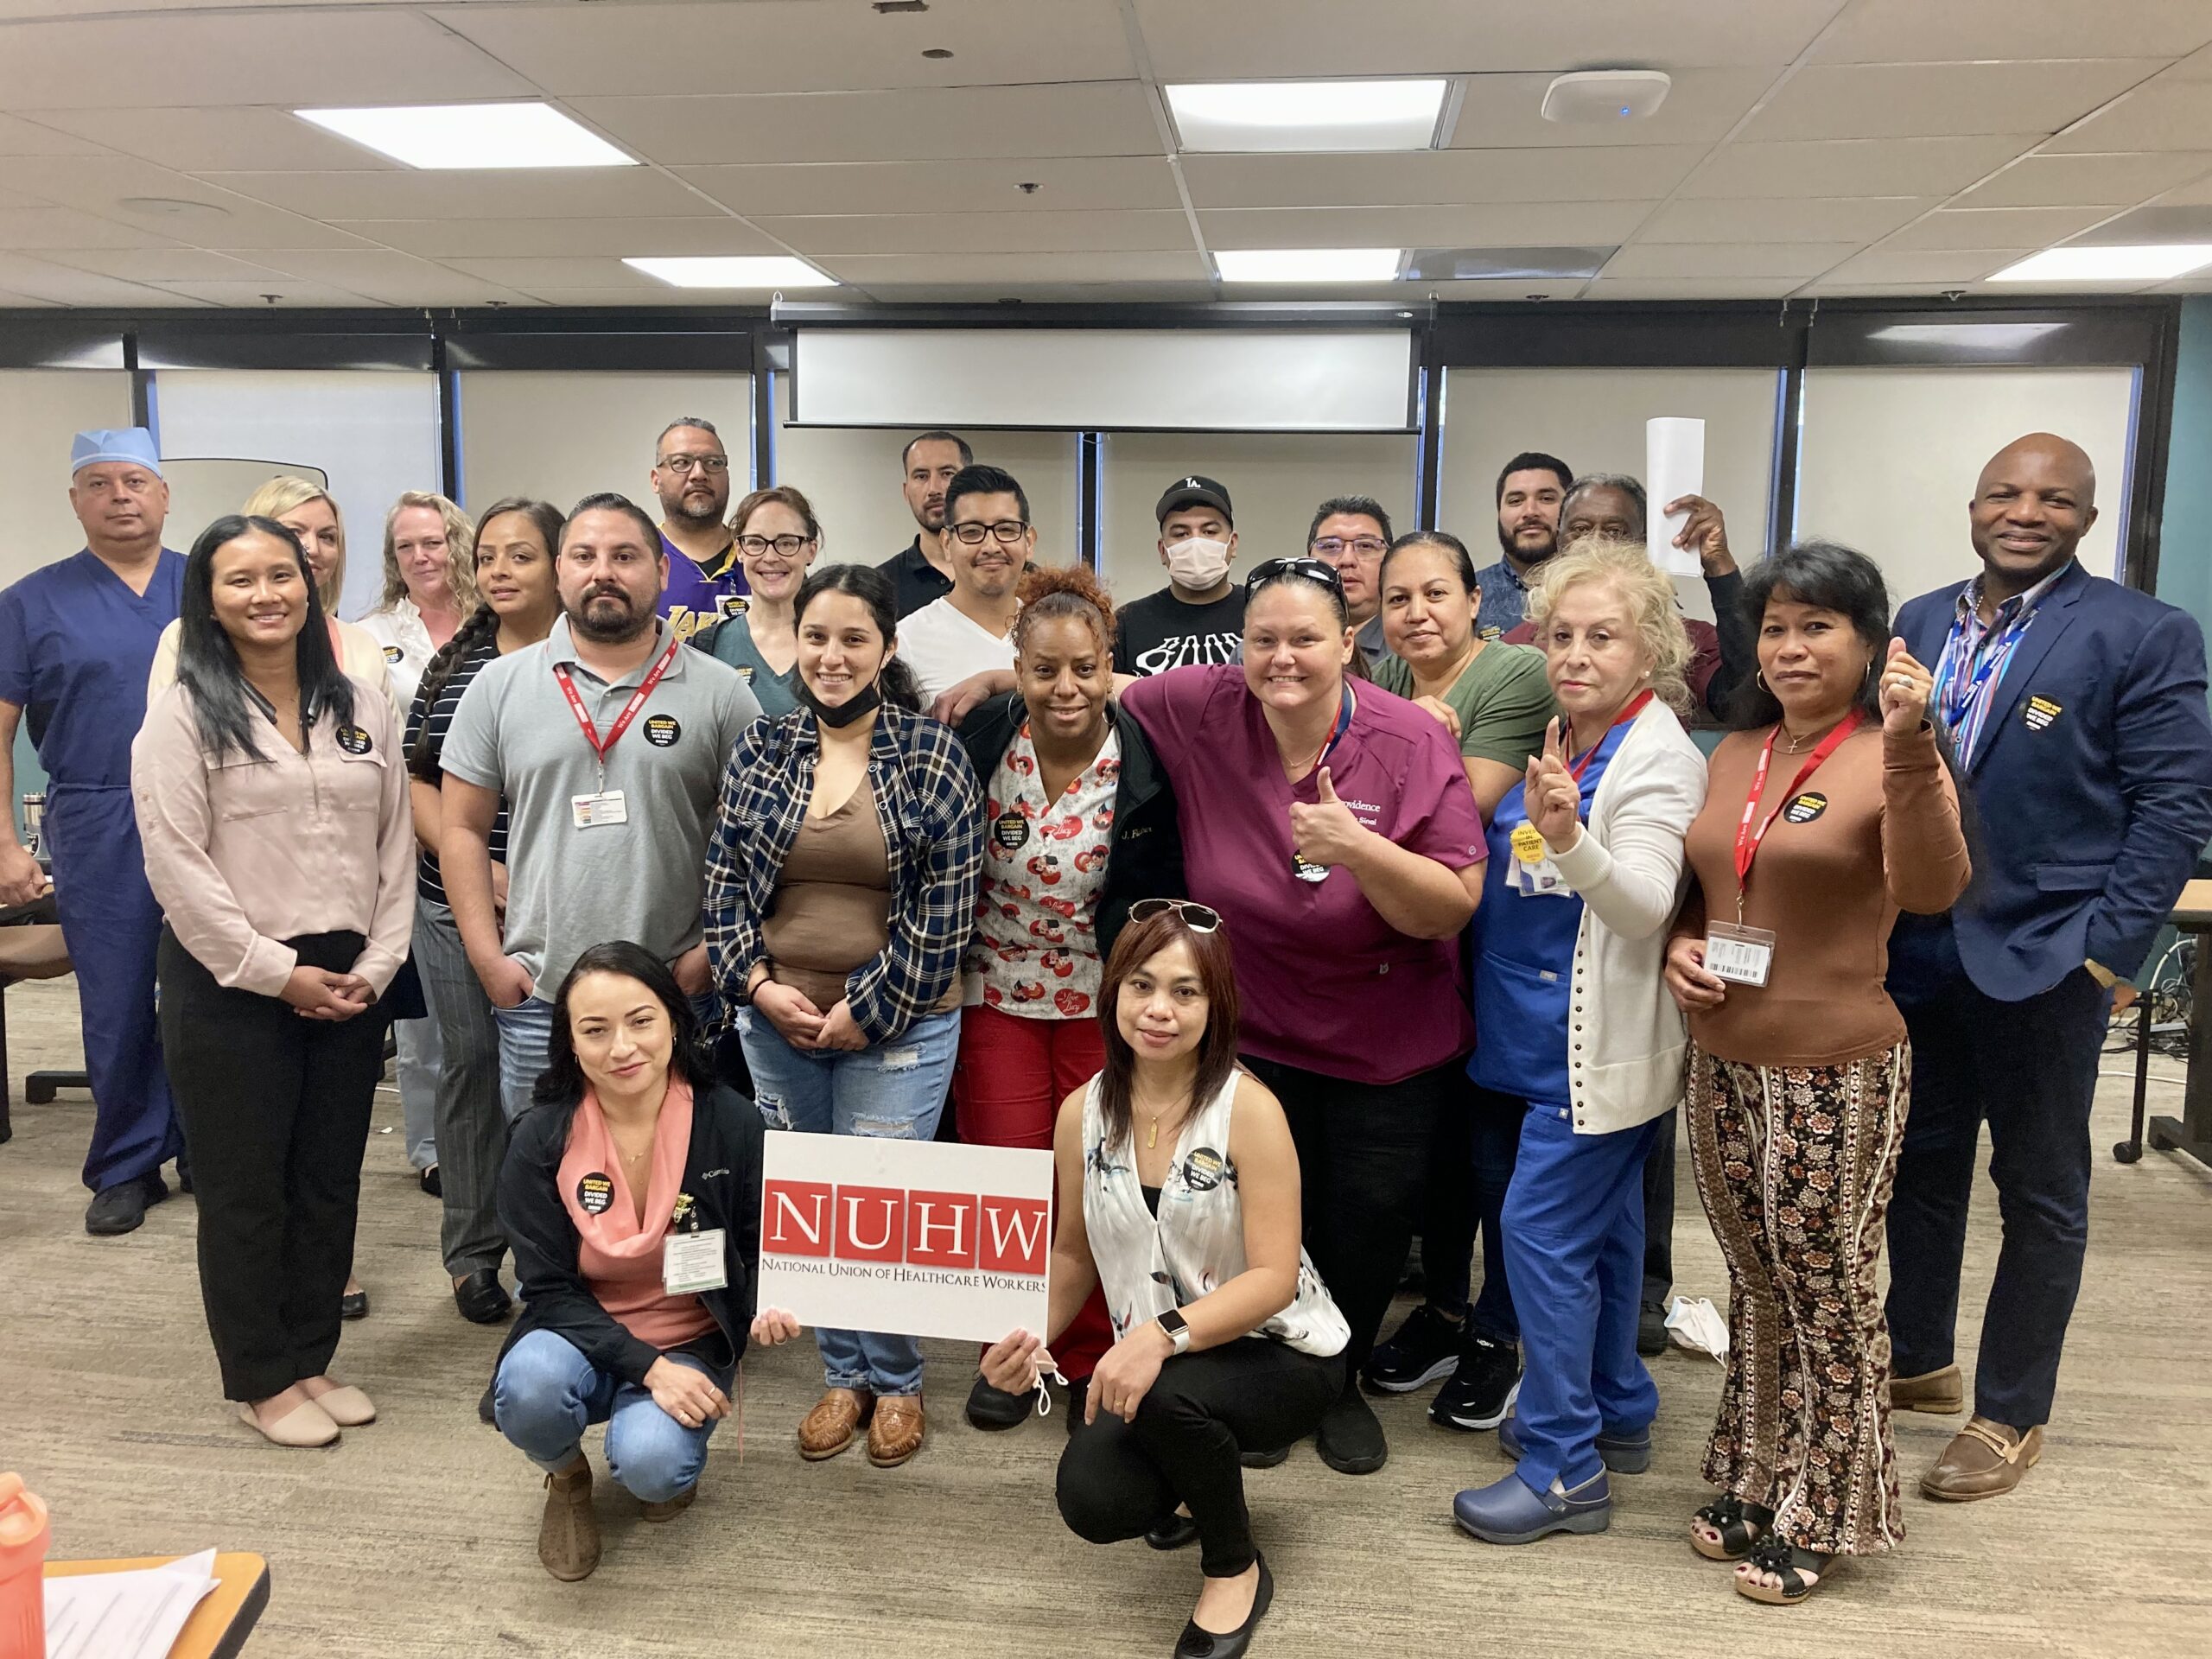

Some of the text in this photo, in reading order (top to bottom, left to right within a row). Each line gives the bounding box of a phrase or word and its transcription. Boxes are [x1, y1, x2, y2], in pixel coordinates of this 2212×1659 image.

[668, 605, 719, 642] LAK
[1344, 800, 1380, 812] ovidence
[769, 1191, 1046, 1260] NUHW
[762, 1258, 825, 1274] NATIONAL
[829, 1263, 872, 1278] UNION
[894, 1268, 979, 1287] HEALTHCARE
